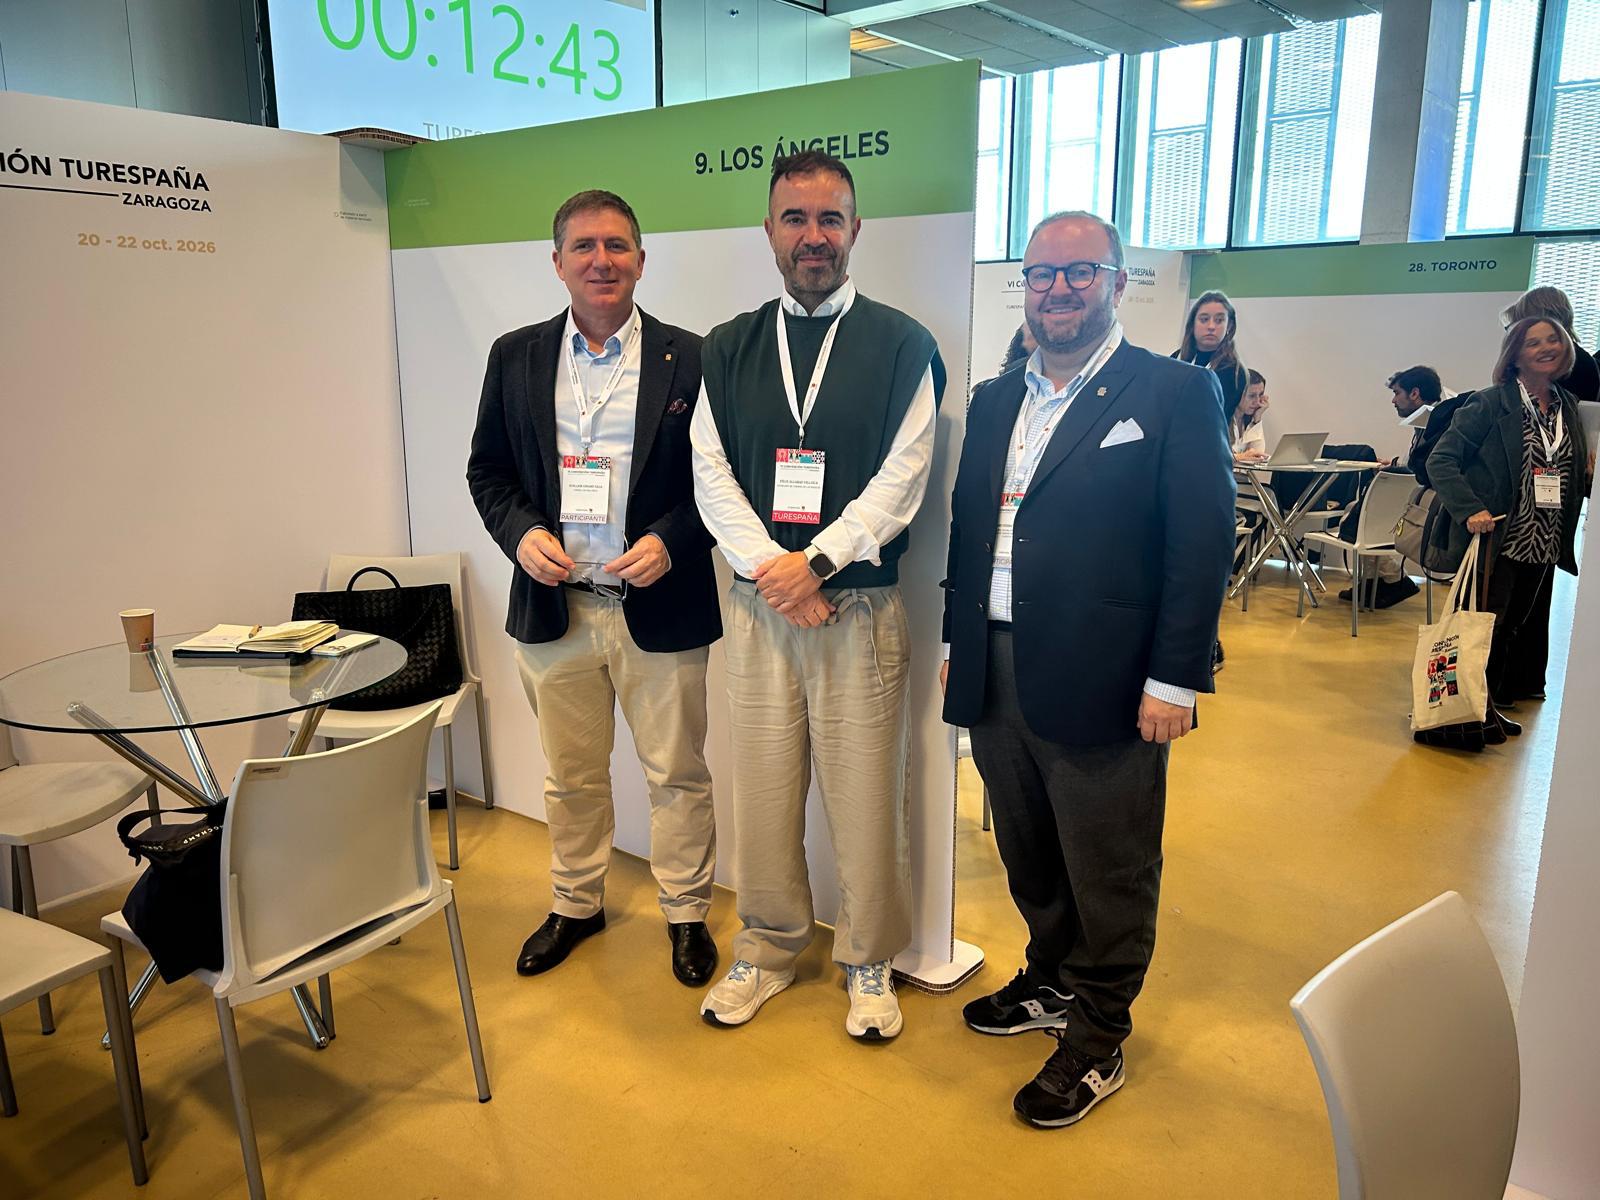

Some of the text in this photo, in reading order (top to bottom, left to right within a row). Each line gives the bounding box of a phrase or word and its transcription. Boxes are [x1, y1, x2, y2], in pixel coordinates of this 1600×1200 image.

[695, 130, 889, 175] 9. LOS ÁNGELES
[59, 158, 209, 191] TURESPAÑA
[122, 192, 212, 212] ZARAGOZA
[78, 233, 100, 246] 20
[117, 235, 137, 249] 22
[142, 238, 172, 251] oct.
[177, 240, 216, 254] 2026
[1408, 260, 1497, 272] 28. TORONTO
[773, 512, 818, 521] TURESPAÑA
